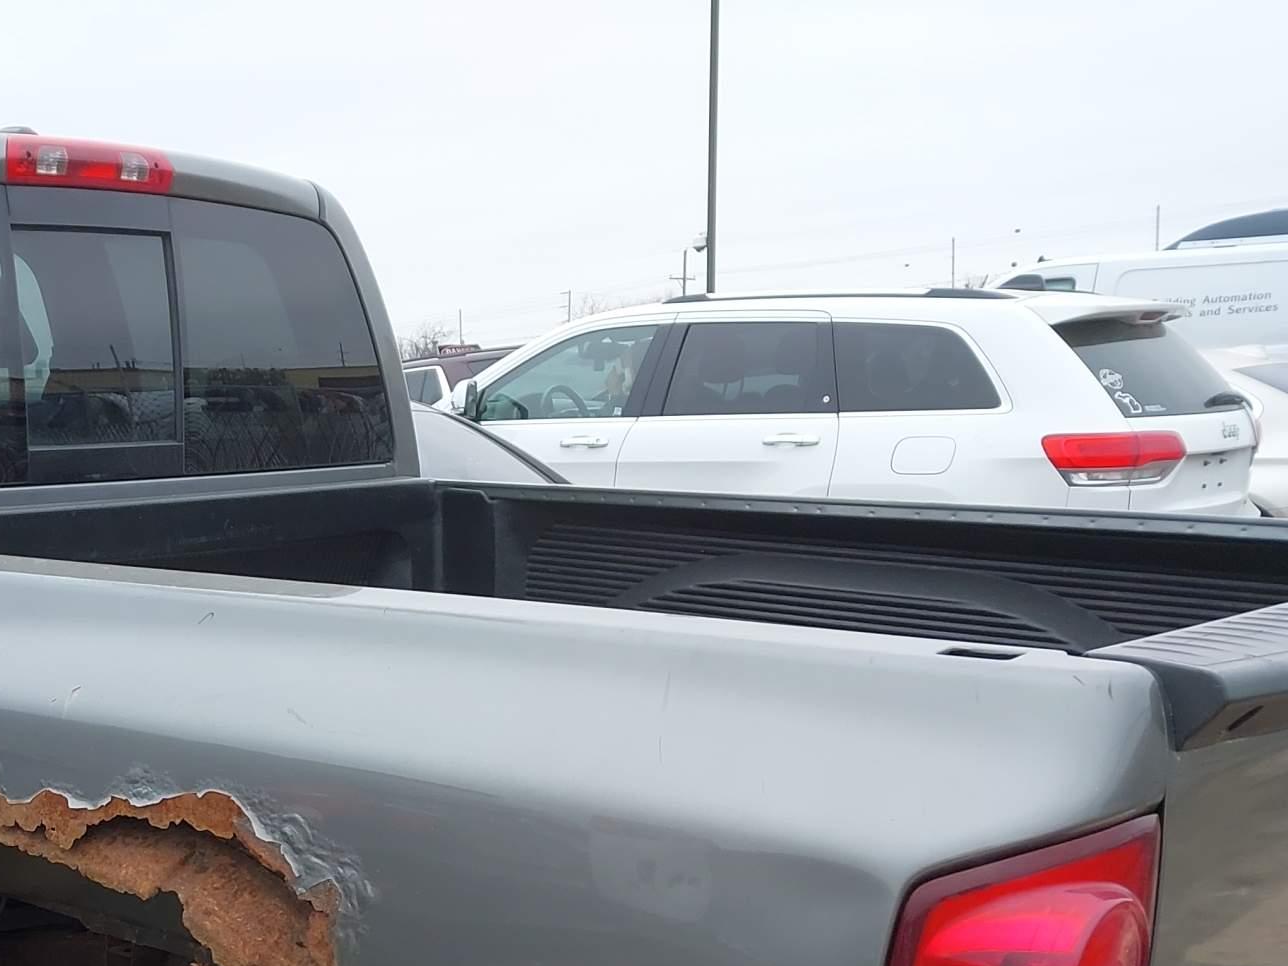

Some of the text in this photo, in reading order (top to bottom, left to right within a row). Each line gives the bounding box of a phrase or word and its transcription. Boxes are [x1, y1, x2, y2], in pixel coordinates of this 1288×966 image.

[1202, 291, 1272, 305] Automation
[1199, 307, 1221, 317] and
[1227, 303, 1279, 315] Services
